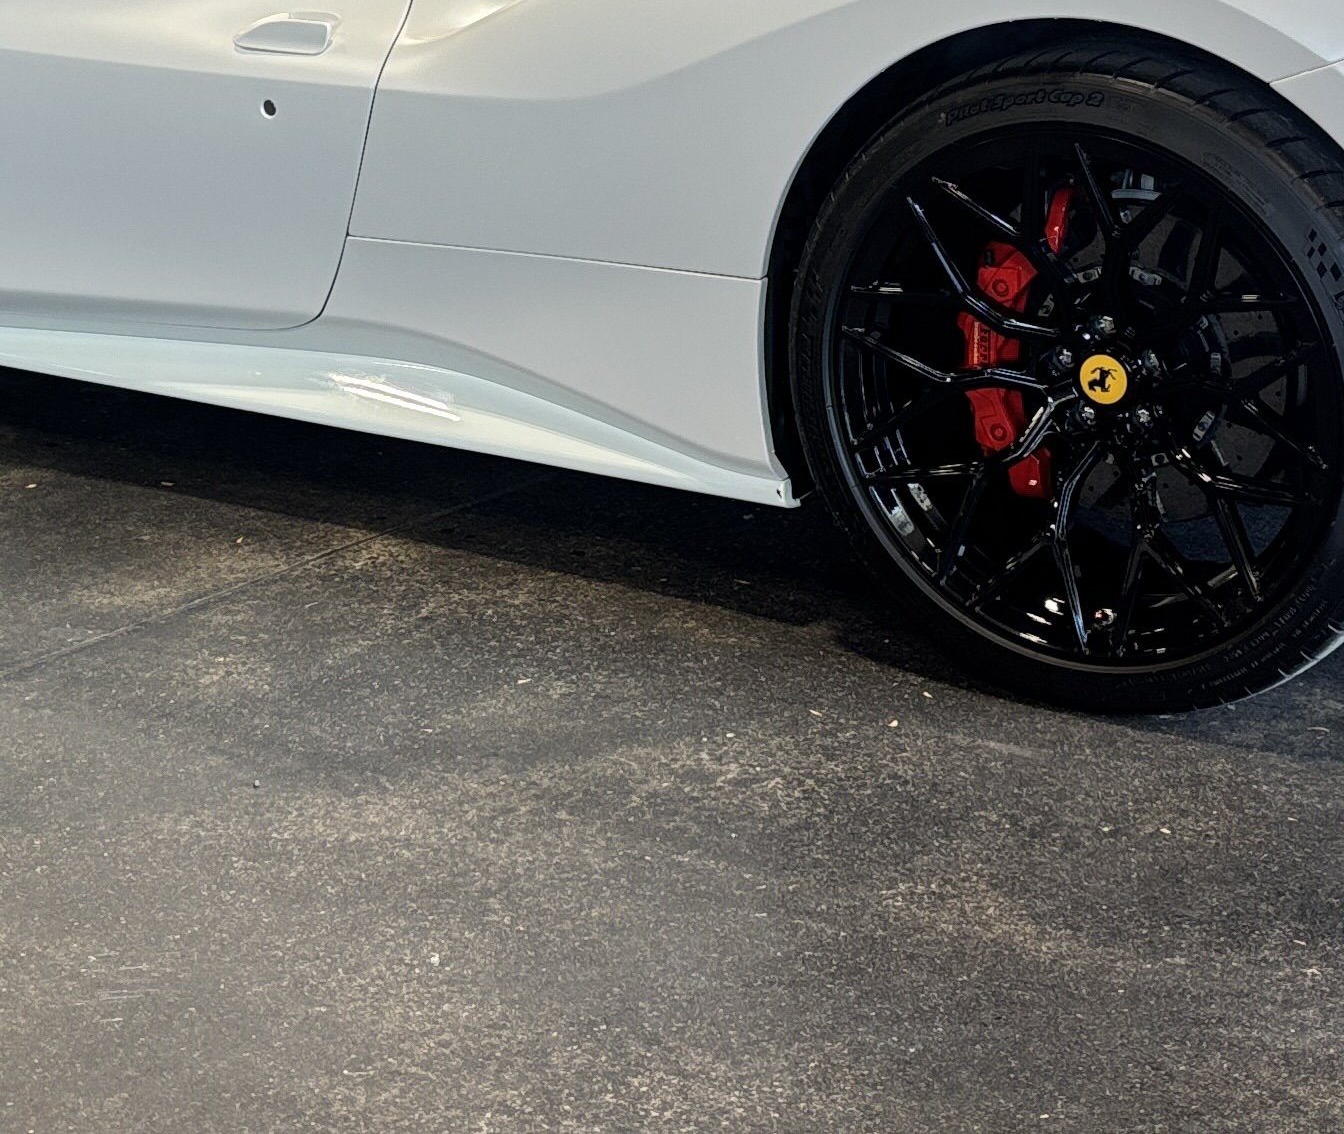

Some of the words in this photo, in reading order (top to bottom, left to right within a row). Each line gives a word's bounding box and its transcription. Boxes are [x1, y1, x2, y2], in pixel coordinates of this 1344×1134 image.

[990, 88, 1046, 112] Sport
[1047, 89, 1084, 107] Cup
[1086, 90, 1105, 108] 2
